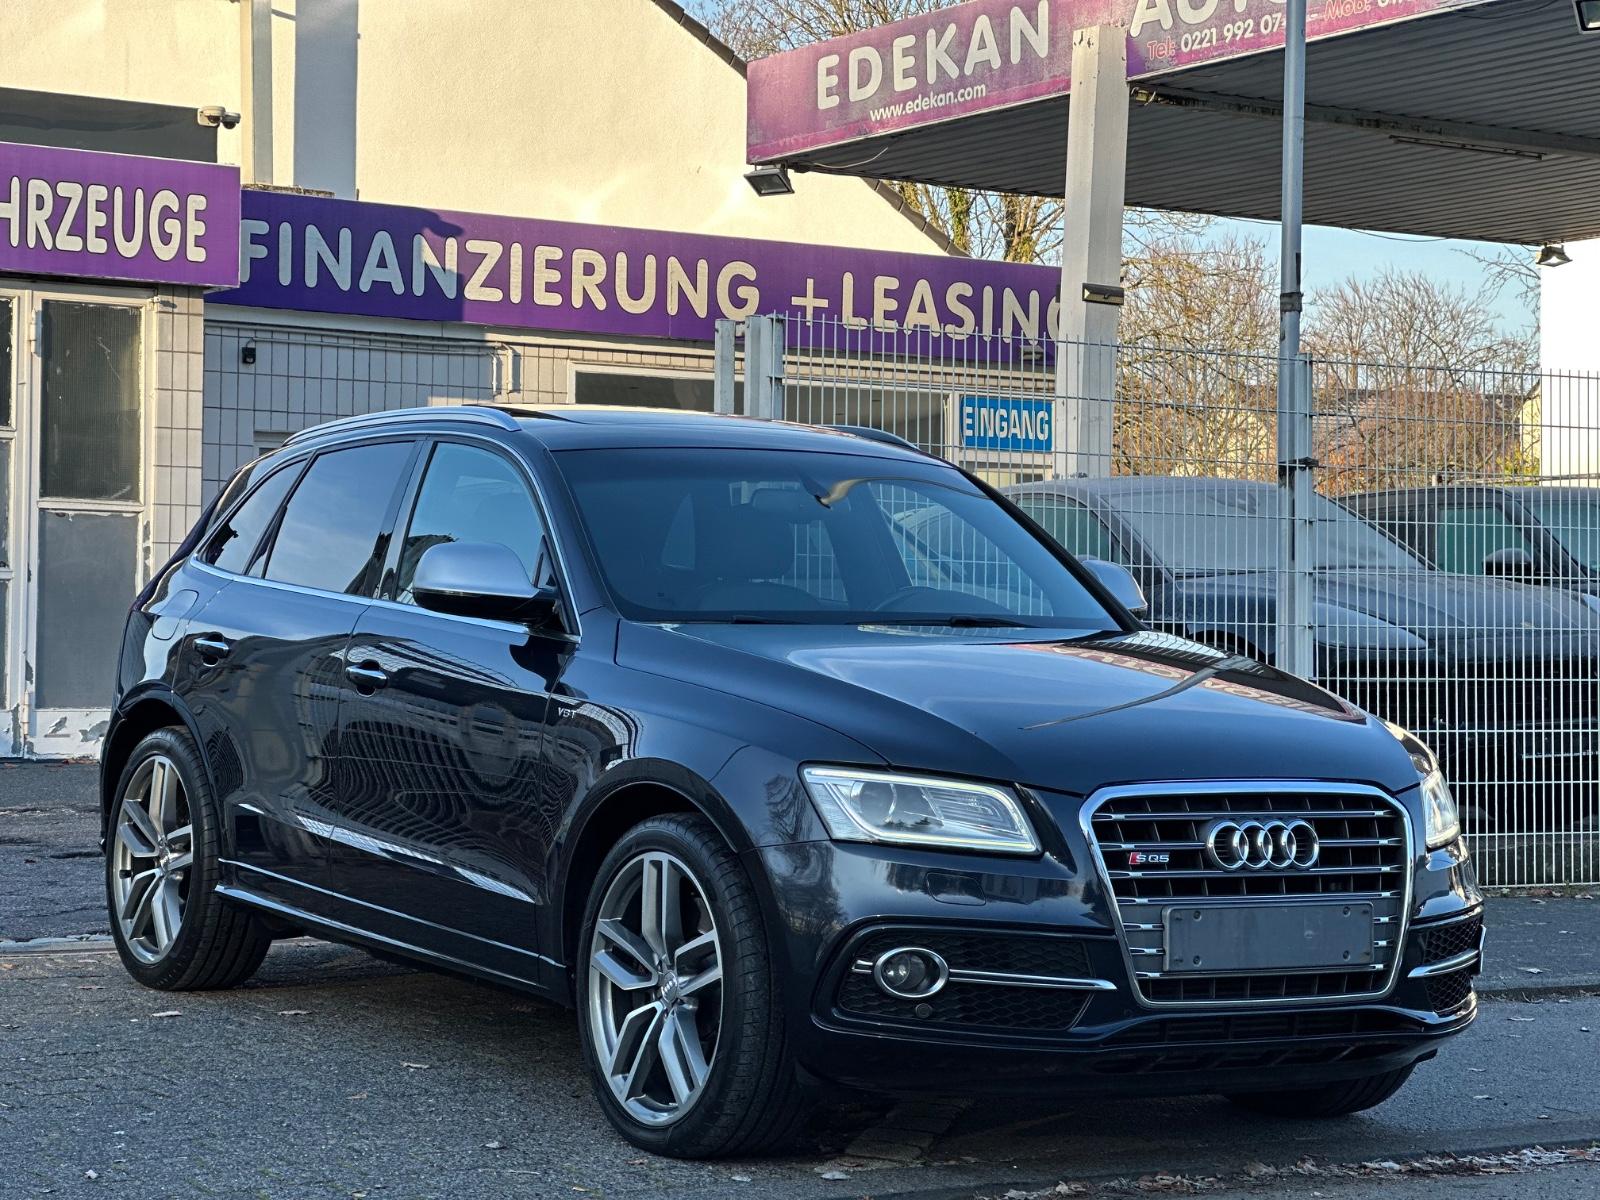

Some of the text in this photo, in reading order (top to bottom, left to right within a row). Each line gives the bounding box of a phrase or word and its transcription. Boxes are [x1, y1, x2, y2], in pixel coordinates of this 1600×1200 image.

[817, 0, 1050, 110] EDEKAN
[1147, 37, 1176, 60] Tel:
[1180, 28, 1217, 53] 0221
[1223, 20, 1254, 43] 992
[1260, 13, 1286, 35] 07
[869, 84, 986, 121] www.edekan.com
[240, 219, 760, 321] FINANZIERUNG
[963, 407, 1049, 441] EINGANG
[1134, 853, 1170, 863] SQ5
